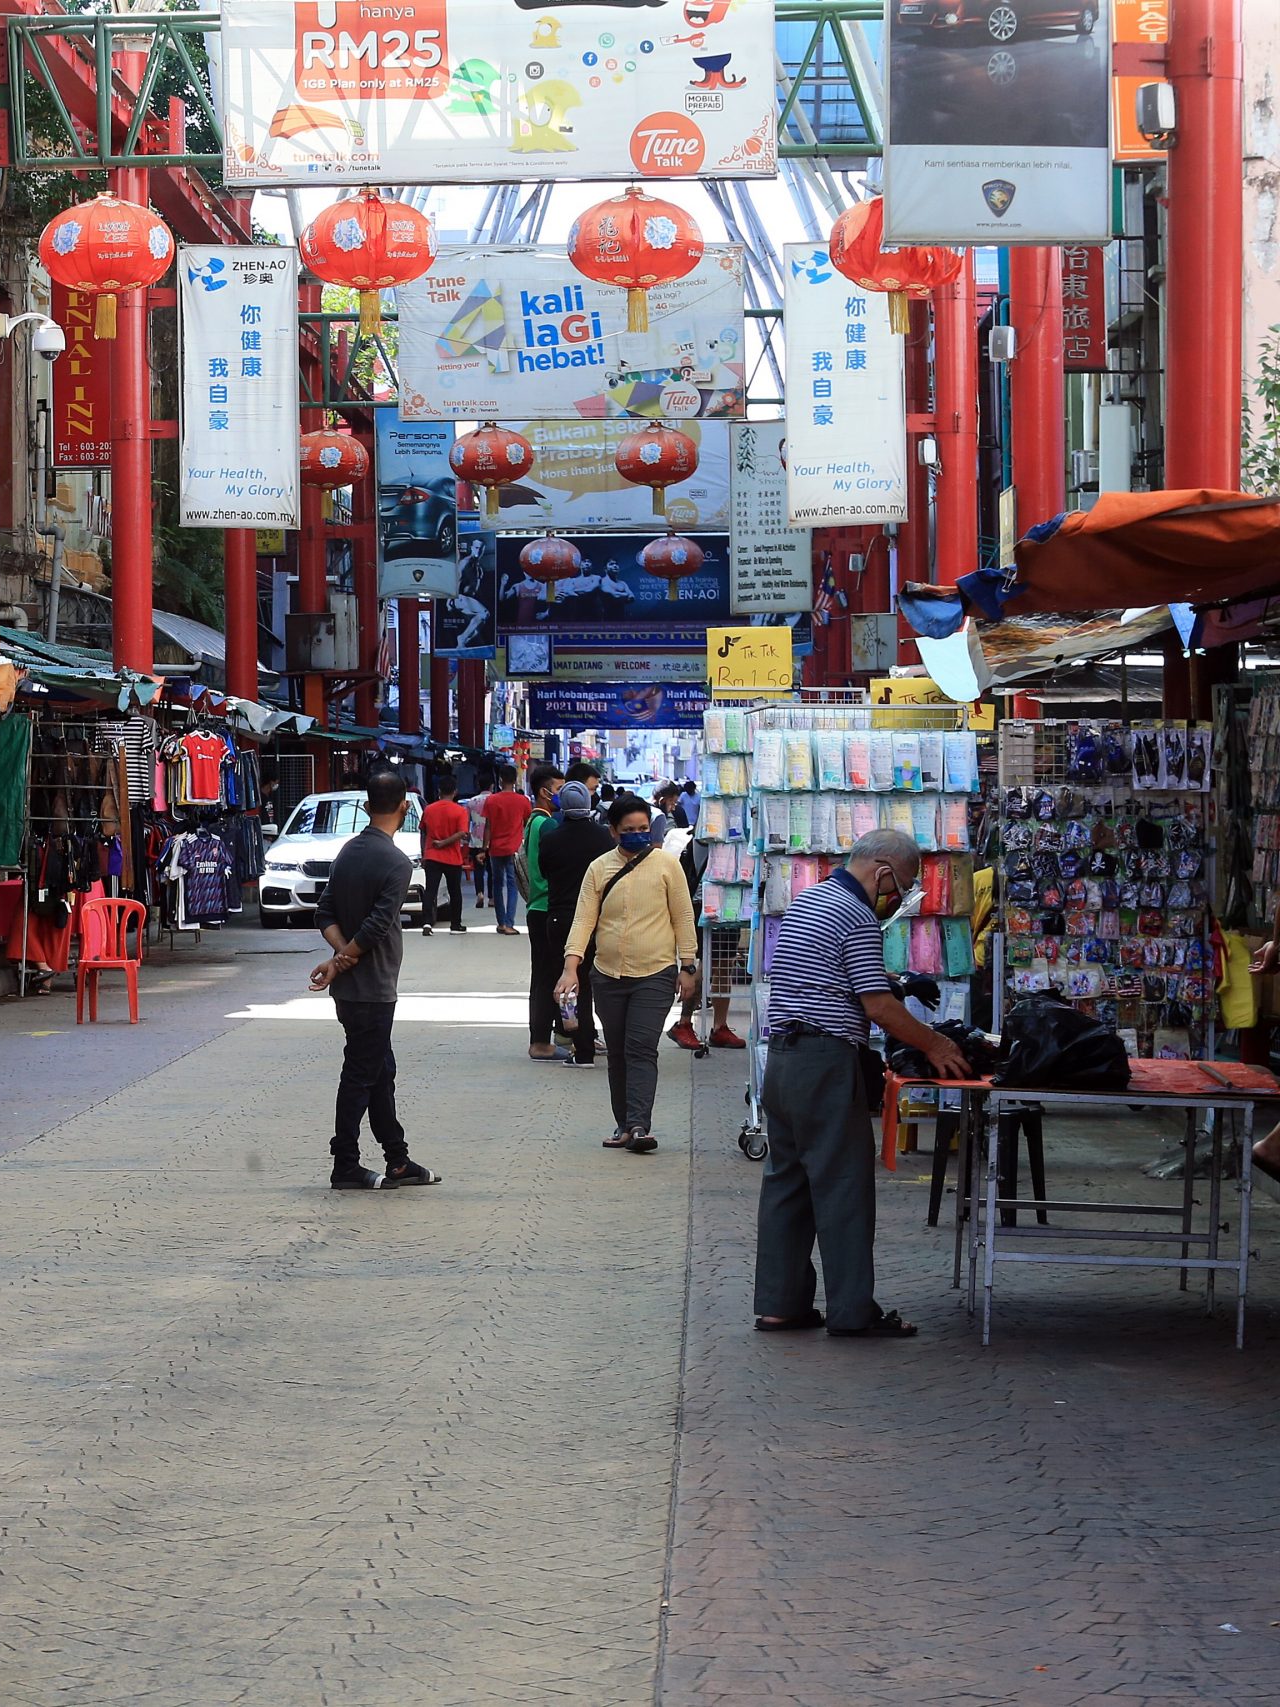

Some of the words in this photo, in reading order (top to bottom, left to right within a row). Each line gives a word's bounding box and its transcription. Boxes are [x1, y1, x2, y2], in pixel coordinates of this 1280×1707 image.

[360, 5, 415, 20] hanya
[302, 30, 442, 69] RM25
[303, 79, 326, 89] 1GB
[330, 79, 356, 89] Plan
[360, 78, 385, 90] only
[389, 79, 402, 88] at
[406, 78, 439, 87] RM25
[638, 129, 700, 164] Tune
[293, 152, 380, 162] tunetalk.com
[654, 156, 683, 167] Talk
[924, 160, 945, 168] Kami
[947, 160, 980, 168] sentiasa
[981, 161, 1031, 169] memberikan
[1032, 161, 1051, 169] lebih
[232, 260, 286, 271] ZHEN-AO
[426, 276, 465, 289] Tune
[427, 290, 460, 303] Talk
[520, 285, 584, 316] kali
[524, 312, 602, 348] laGi
[845, 296, 866, 370] 你健康
[240, 305, 262, 377] 你健康
[518, 343, 605, 373] hebat!
[437, 362, 462, 371] Hitting
[464, 361, 479, 369] your
[209, 358, 229, 430] 我自豪
[812, 351, 834, 425] 我自豪
[664, 391, 697, 410] Tune
[389, 432, 447, 440] Persona
[534, 423, 596, 443] Bukan
[59, 443, 70, 451] Tel
[59, 453, 73, 461] Fax
[188, 468, 215, 479] Your
[220, 468, 267, 480] Health,
[539, 469, 567, 480] More
[571, 465, 596, 476] than
[597, 463, 617, 475] just
[793, 464, 822, 476] Your
[827, 462, 875, 476] Health,
[833, 479, 852, 491] My
[856, 477, 892, 492] Glory
[225, 485, 243, 497] My
[248, 485, 283, 498] Glory
[186, 508, 295, 525] www.zhen-ao.com.my
[794, 504, 905, 518] www.zhen-ao.com.my
[614, 661, 651, 669] WELCOME
[537, 691, 556, 699] Hari
[559, 691, 617, 700] Kebangsaan
[667, 690, 687, 698] Hari
[545, 702, 571, 711] 2021
